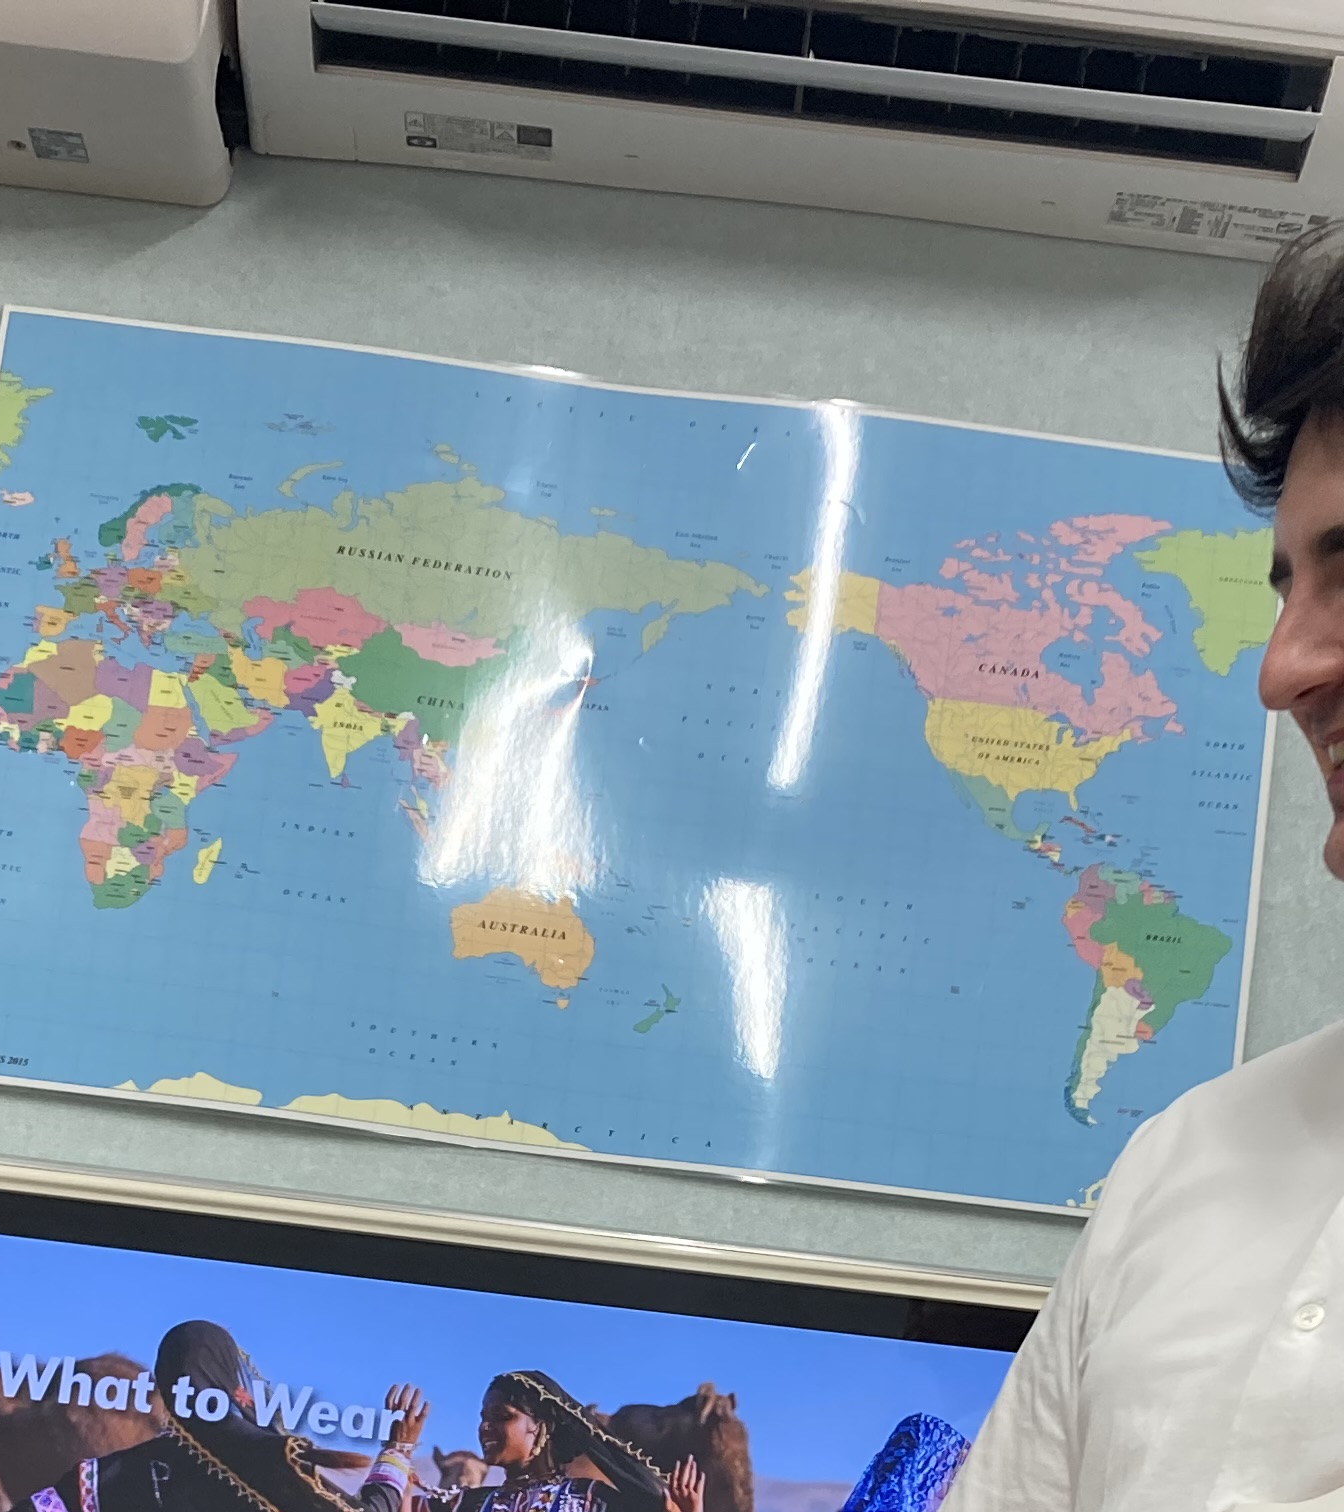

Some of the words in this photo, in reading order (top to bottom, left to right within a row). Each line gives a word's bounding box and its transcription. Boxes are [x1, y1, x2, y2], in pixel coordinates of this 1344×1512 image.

[336, 545, 405, 563] RUSSIAN
[412, 556, 513, 581] FEDERATION
[978, 663, 1041, 681] CANADA
[417, 695, 466, 712] CHINA
[333, 721, 364, 732] INDIA
[477, 918, 568, 942] AUSTRALIA
[1145, 933, 1183, 945] BRAZIL
[171, 1375, 231, 1423] to
[253, 1380, 406, 1444] Wear
